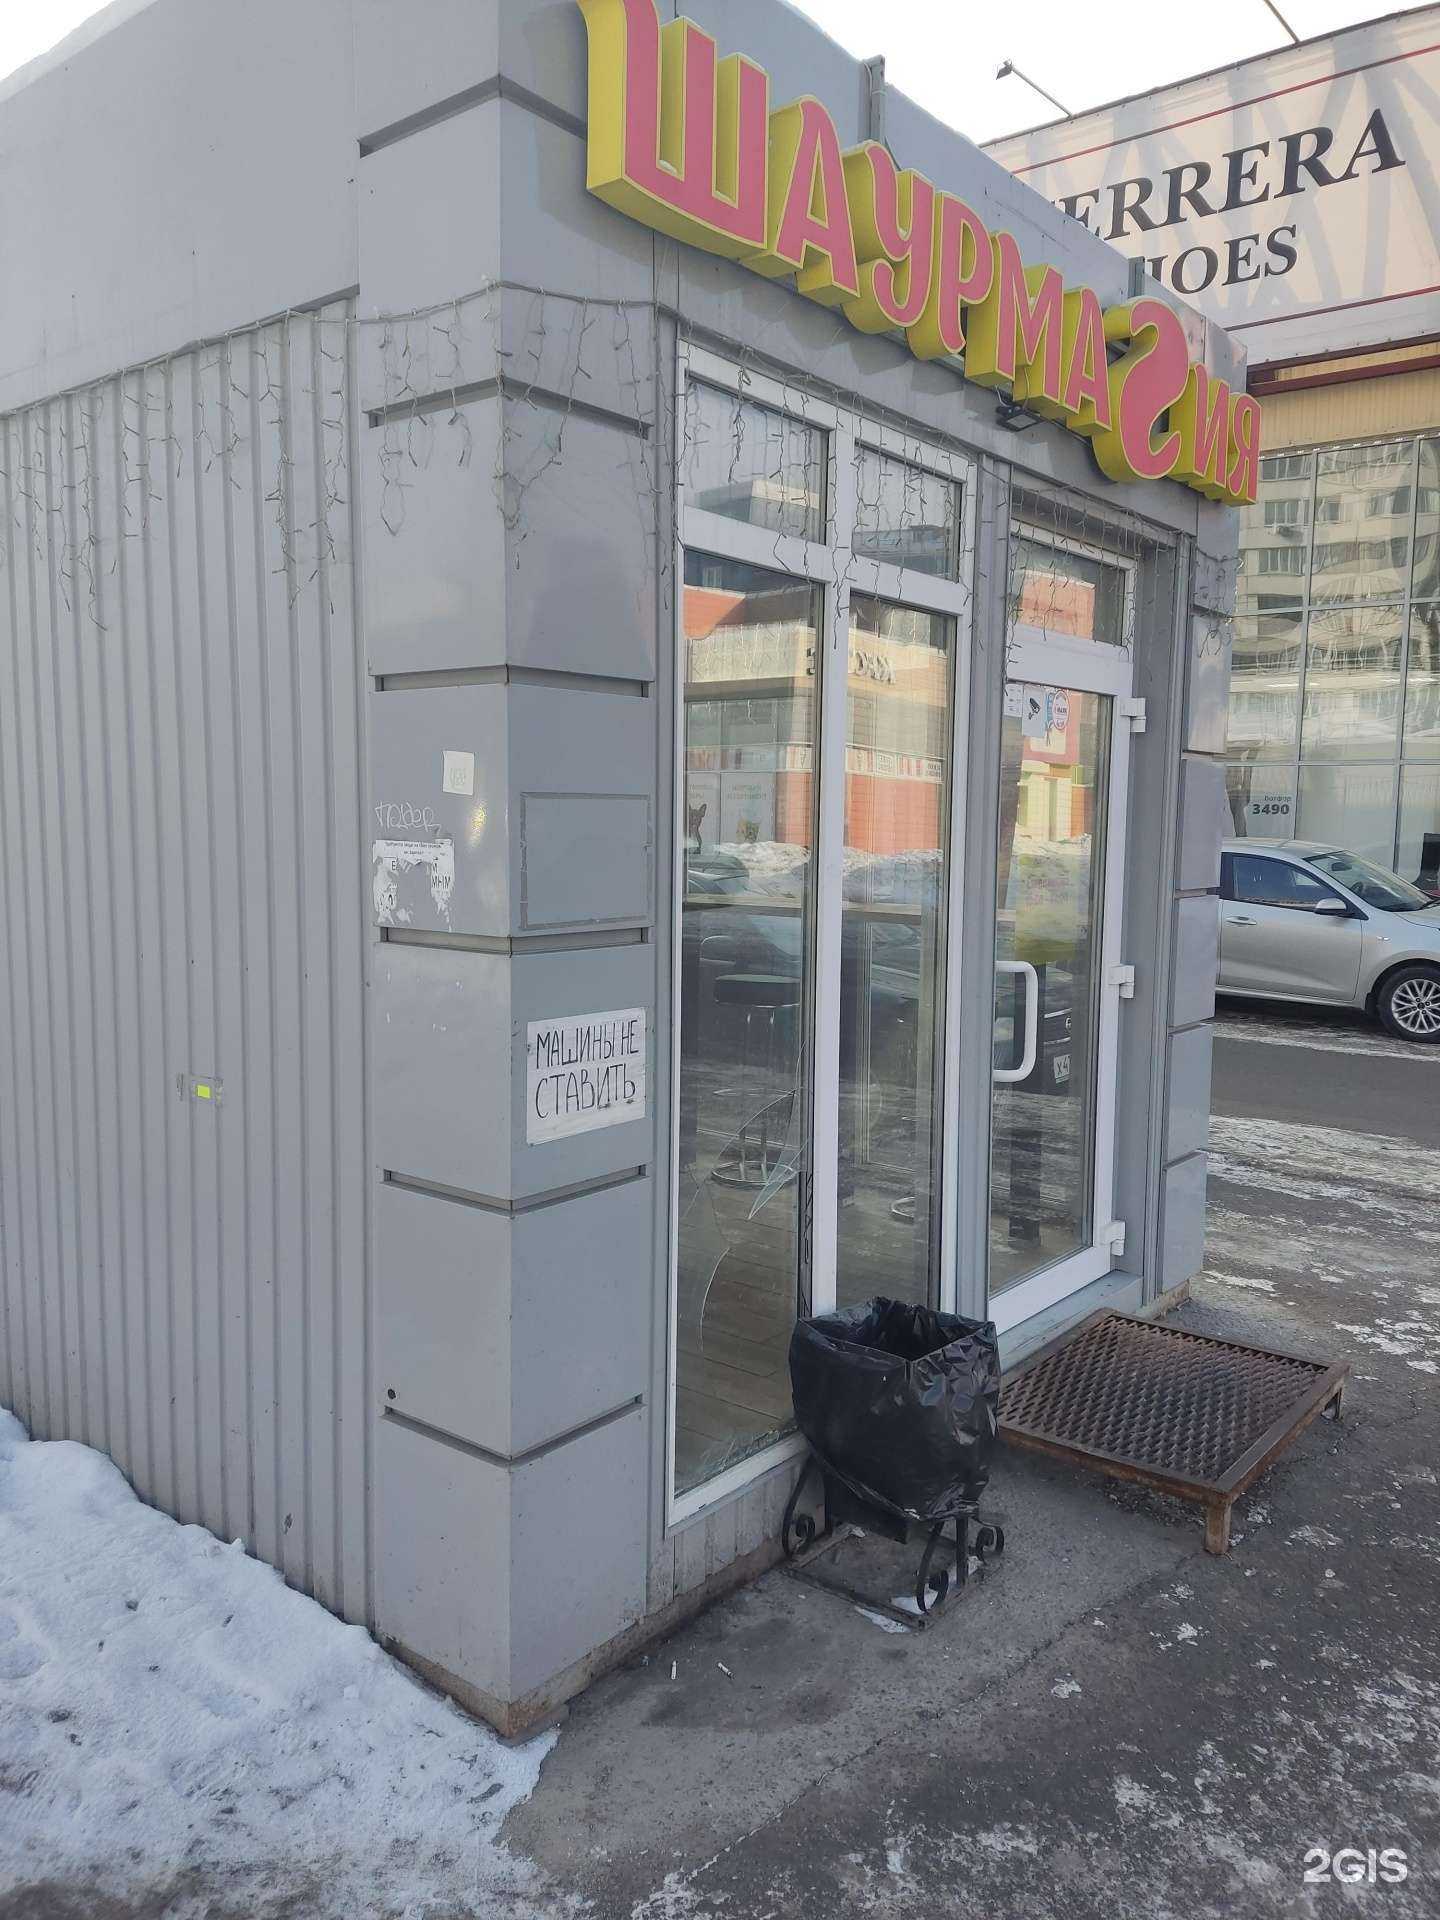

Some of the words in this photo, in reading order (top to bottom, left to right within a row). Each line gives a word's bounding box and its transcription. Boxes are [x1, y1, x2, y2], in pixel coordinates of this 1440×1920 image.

[1051, 108, 1406, 241] ERRERA
[1252, 803, 1290, 815] 3490
[536, 1022, 616, 1069] МАШИНЫ
[620, 1019, 639, 1055] НЕ
[535, 1063, 636, 1118] СТАВИТЬ
